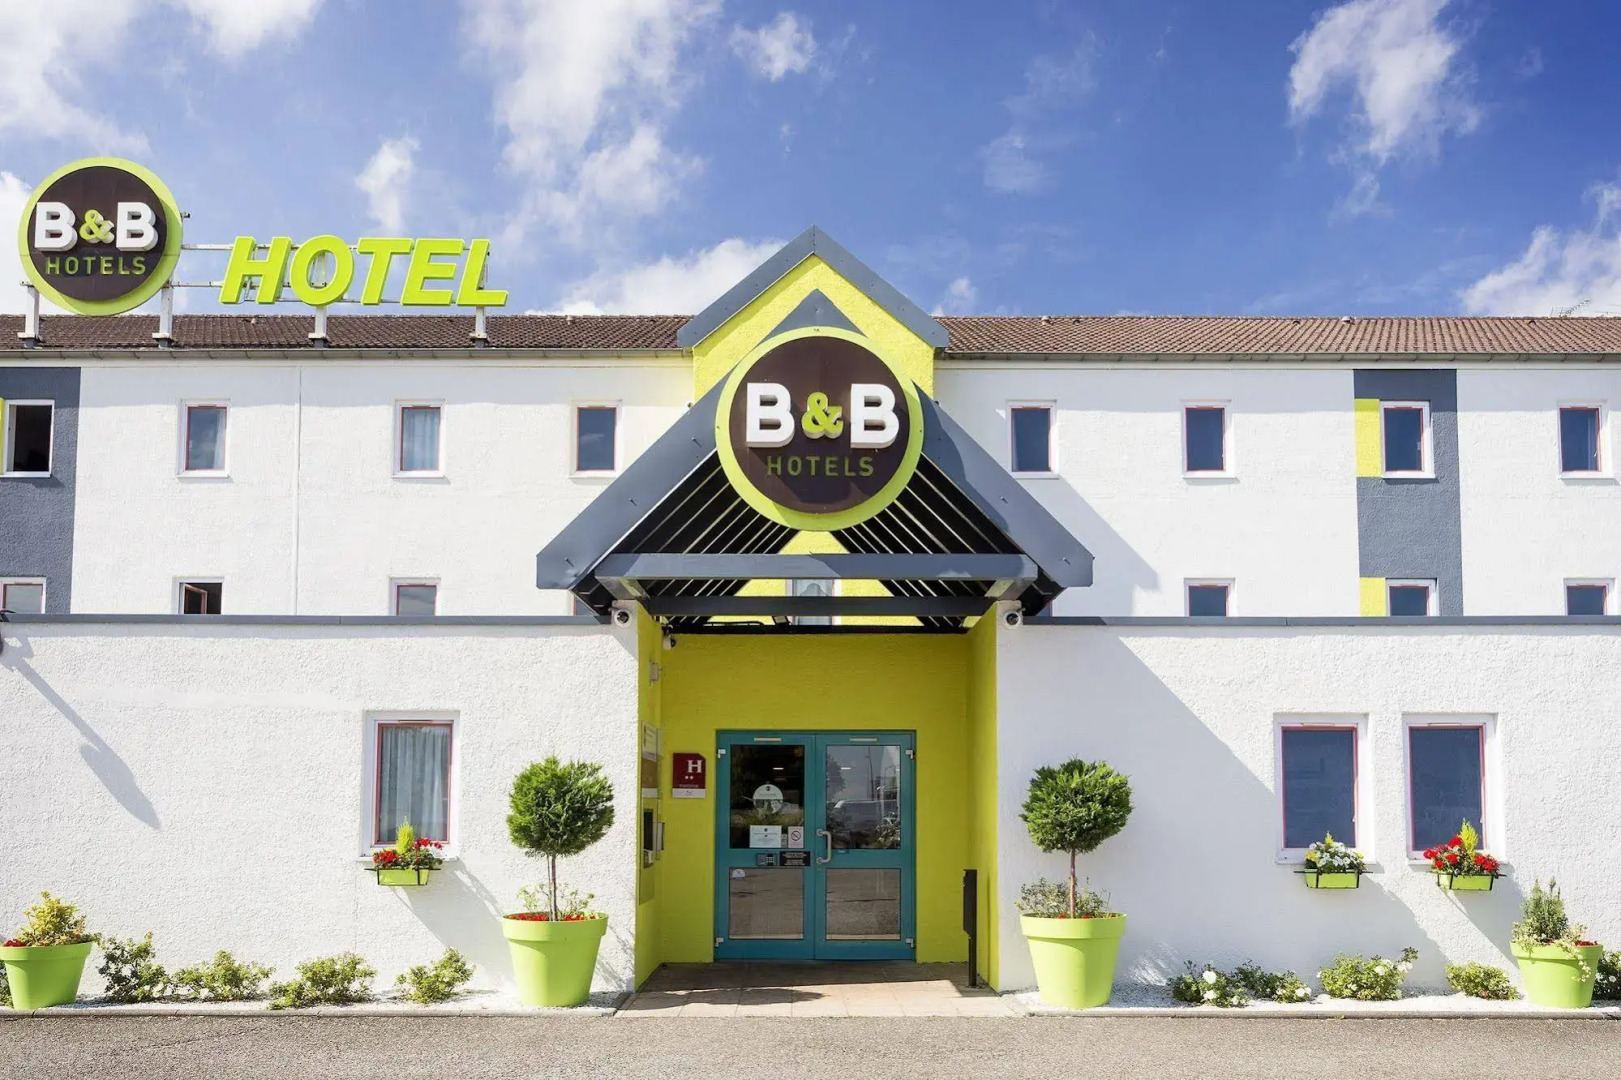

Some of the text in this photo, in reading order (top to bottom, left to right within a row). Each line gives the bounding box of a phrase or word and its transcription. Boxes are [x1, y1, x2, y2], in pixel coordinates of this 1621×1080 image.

[34, 201, 159, 252] B&B
[45, 256, 147, 275] HOTELS
[219, 234, 508, 306] HOTEL
[746, 382, 900, 449] B&B
[766, 455, 875, 477] HOTELS
[687, 759, 703, 774] H
